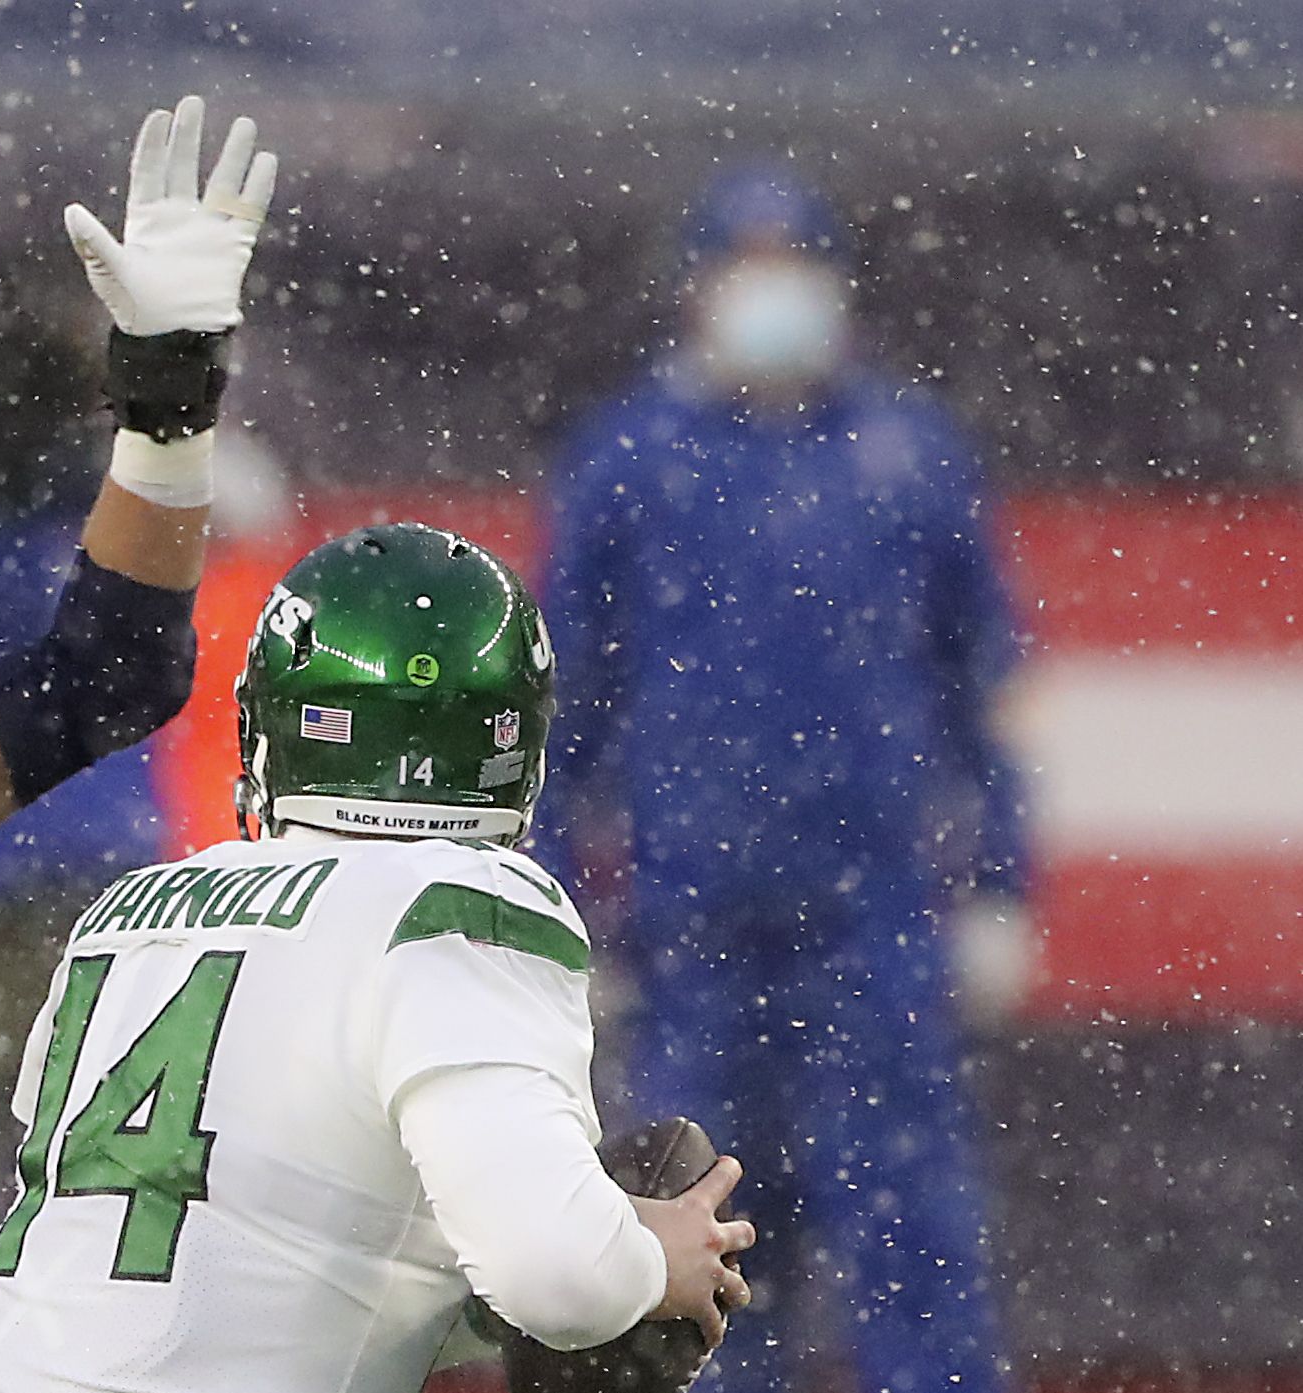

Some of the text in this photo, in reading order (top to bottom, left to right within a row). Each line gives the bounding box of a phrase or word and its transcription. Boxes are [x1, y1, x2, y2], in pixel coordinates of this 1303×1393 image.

[399, 755, 434, 787] 14
[336, 809, 479, 831] BLACK LIVES MATTER
[73, 858, 339, 942] DARNOLD
